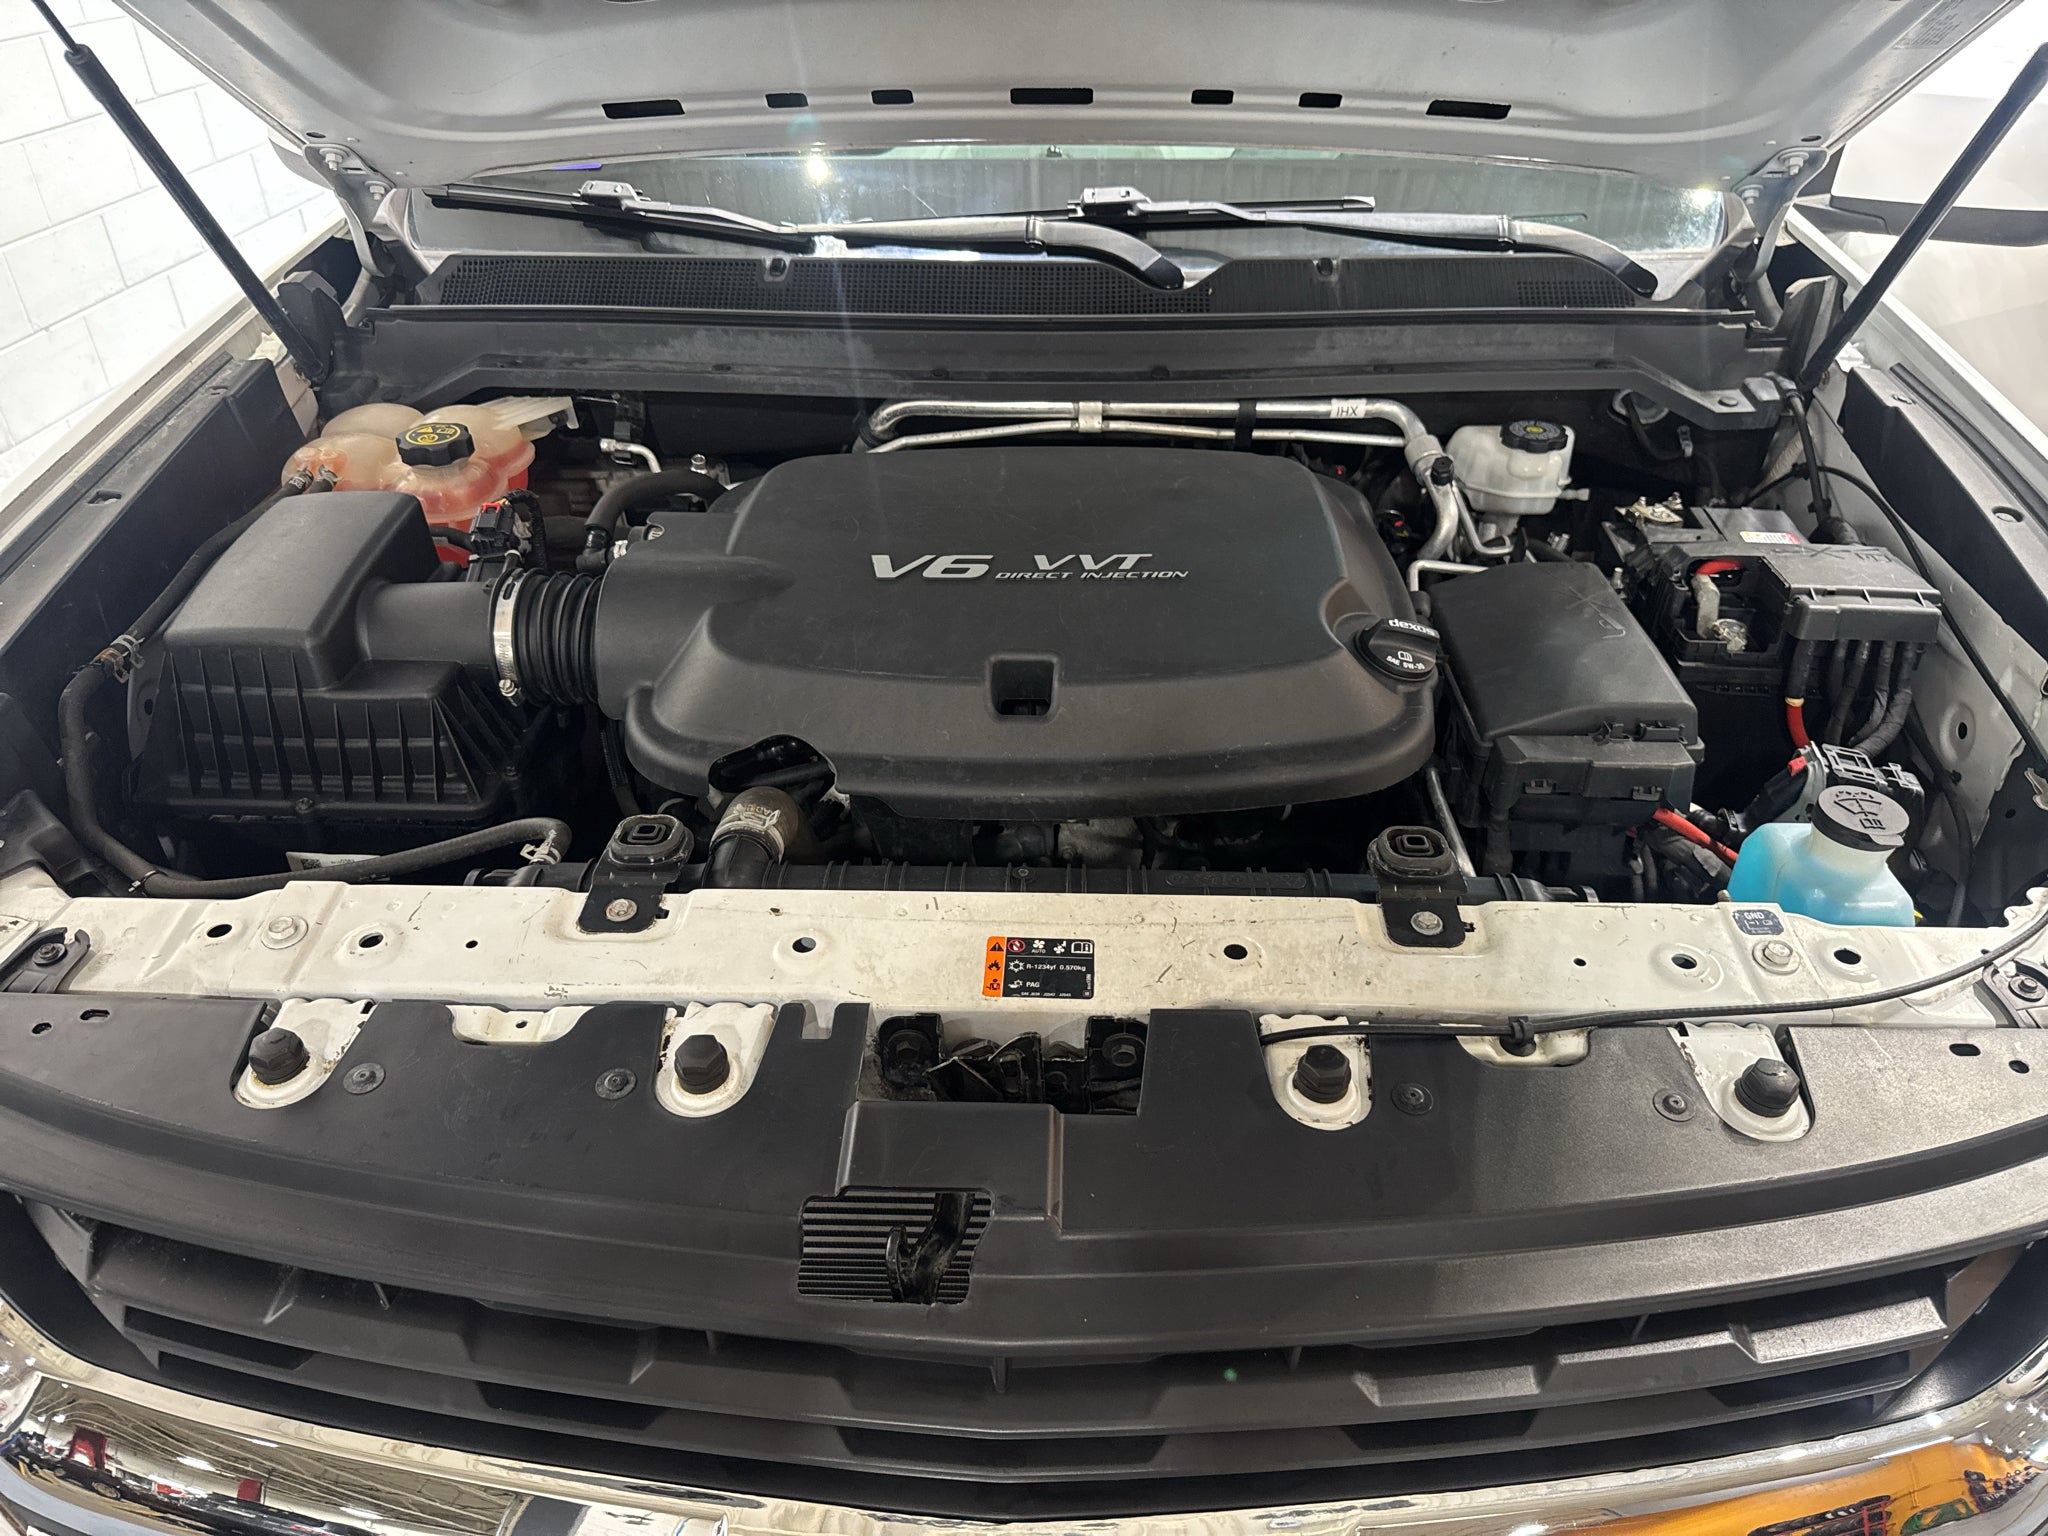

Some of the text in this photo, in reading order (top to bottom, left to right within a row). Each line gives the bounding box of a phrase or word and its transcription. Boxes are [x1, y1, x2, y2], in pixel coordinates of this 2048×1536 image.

[871, 553, 1153, 579] V6 VVT
[995, 570, 1189, 580] DIRECT INJECTION
[1388, 618, 1436, 637] dexos
[1386, 655, 1401, 666] SAE
[1743, 911, 1765, 920] GND
[1026, 963, 1086, 972] R-1234yf 0.570kg
